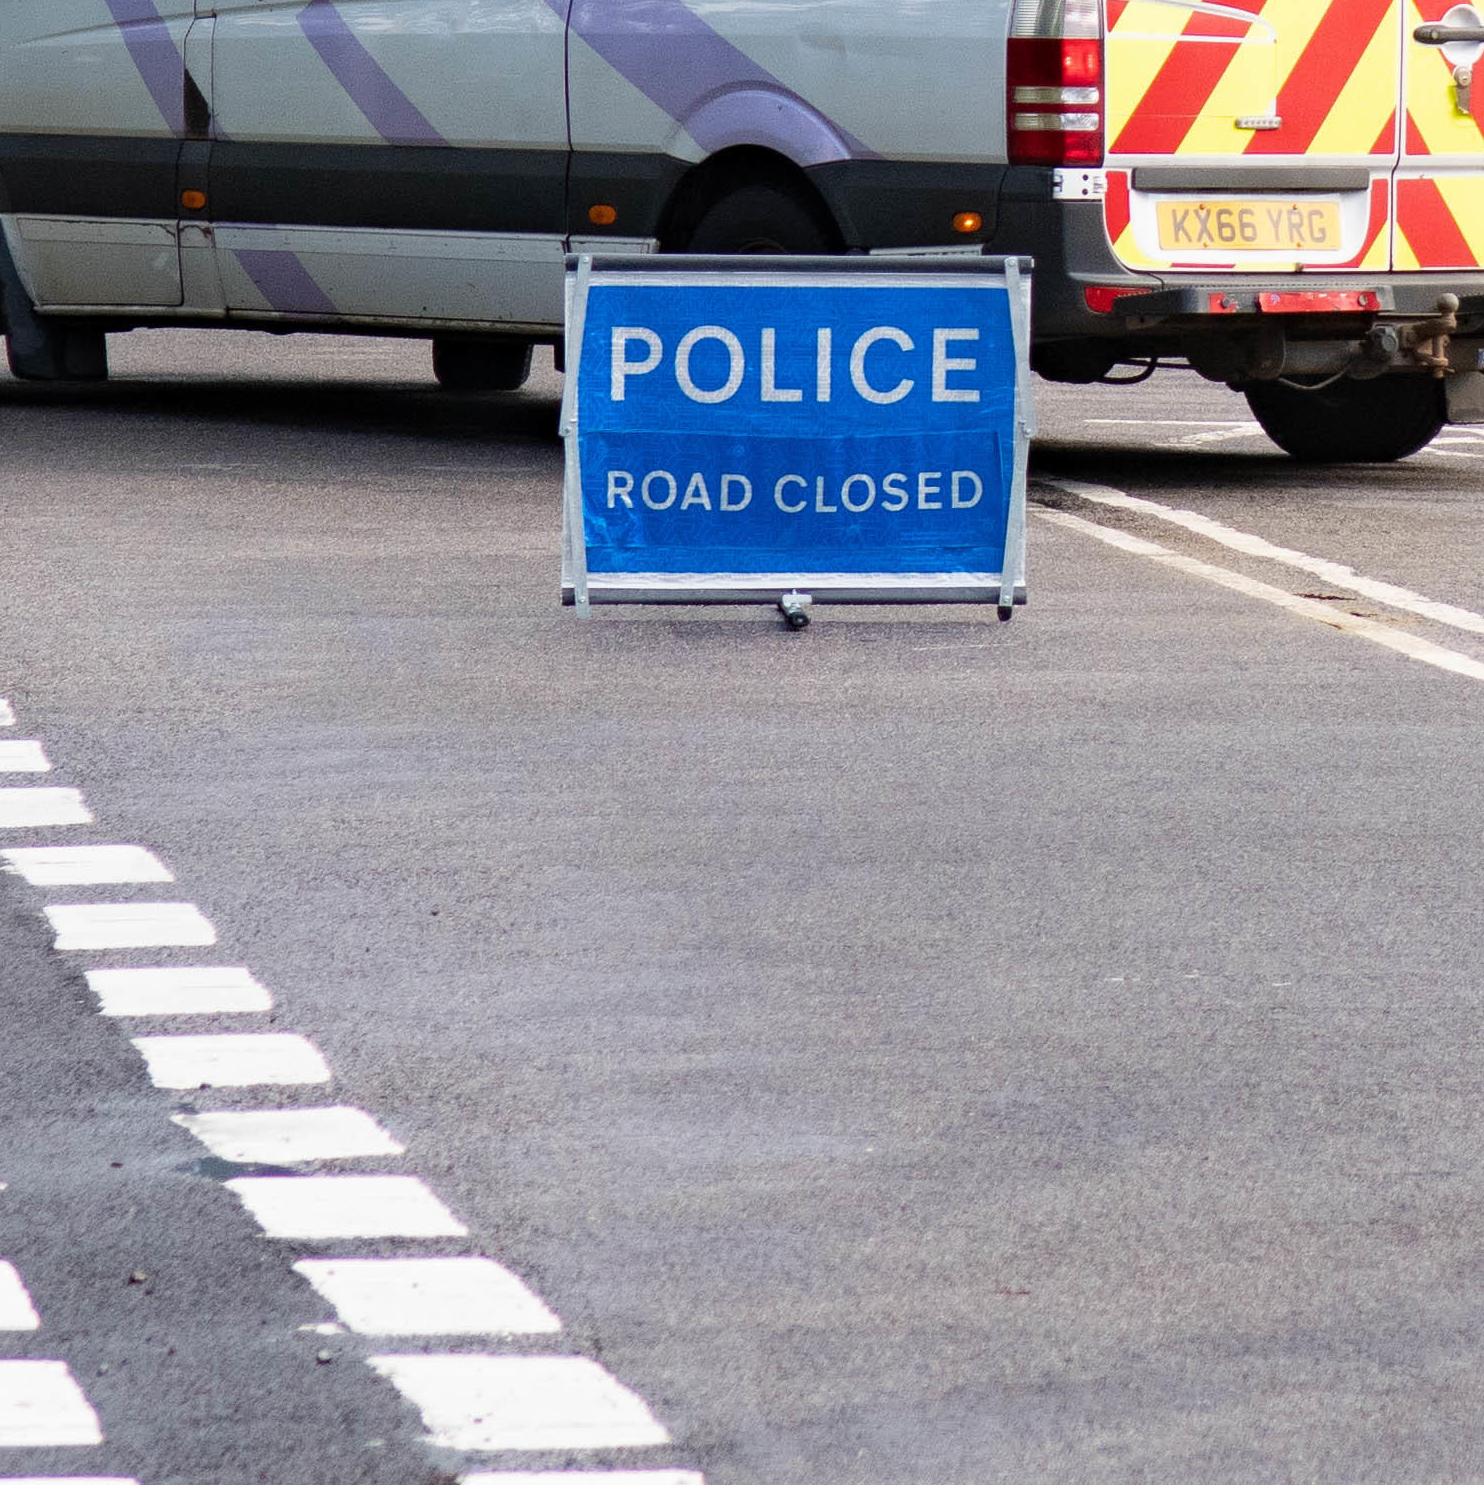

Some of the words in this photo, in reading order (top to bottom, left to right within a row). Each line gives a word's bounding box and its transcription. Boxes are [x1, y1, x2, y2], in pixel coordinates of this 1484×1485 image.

[1171, 208, 1258, 243] KX66
[1266, 208, 1328, 244] YRG
[610, 325, 981, 405] POLICE
[606, 470, 754, 512] ROAD
[773, 470, 984, 514] CLOSED
